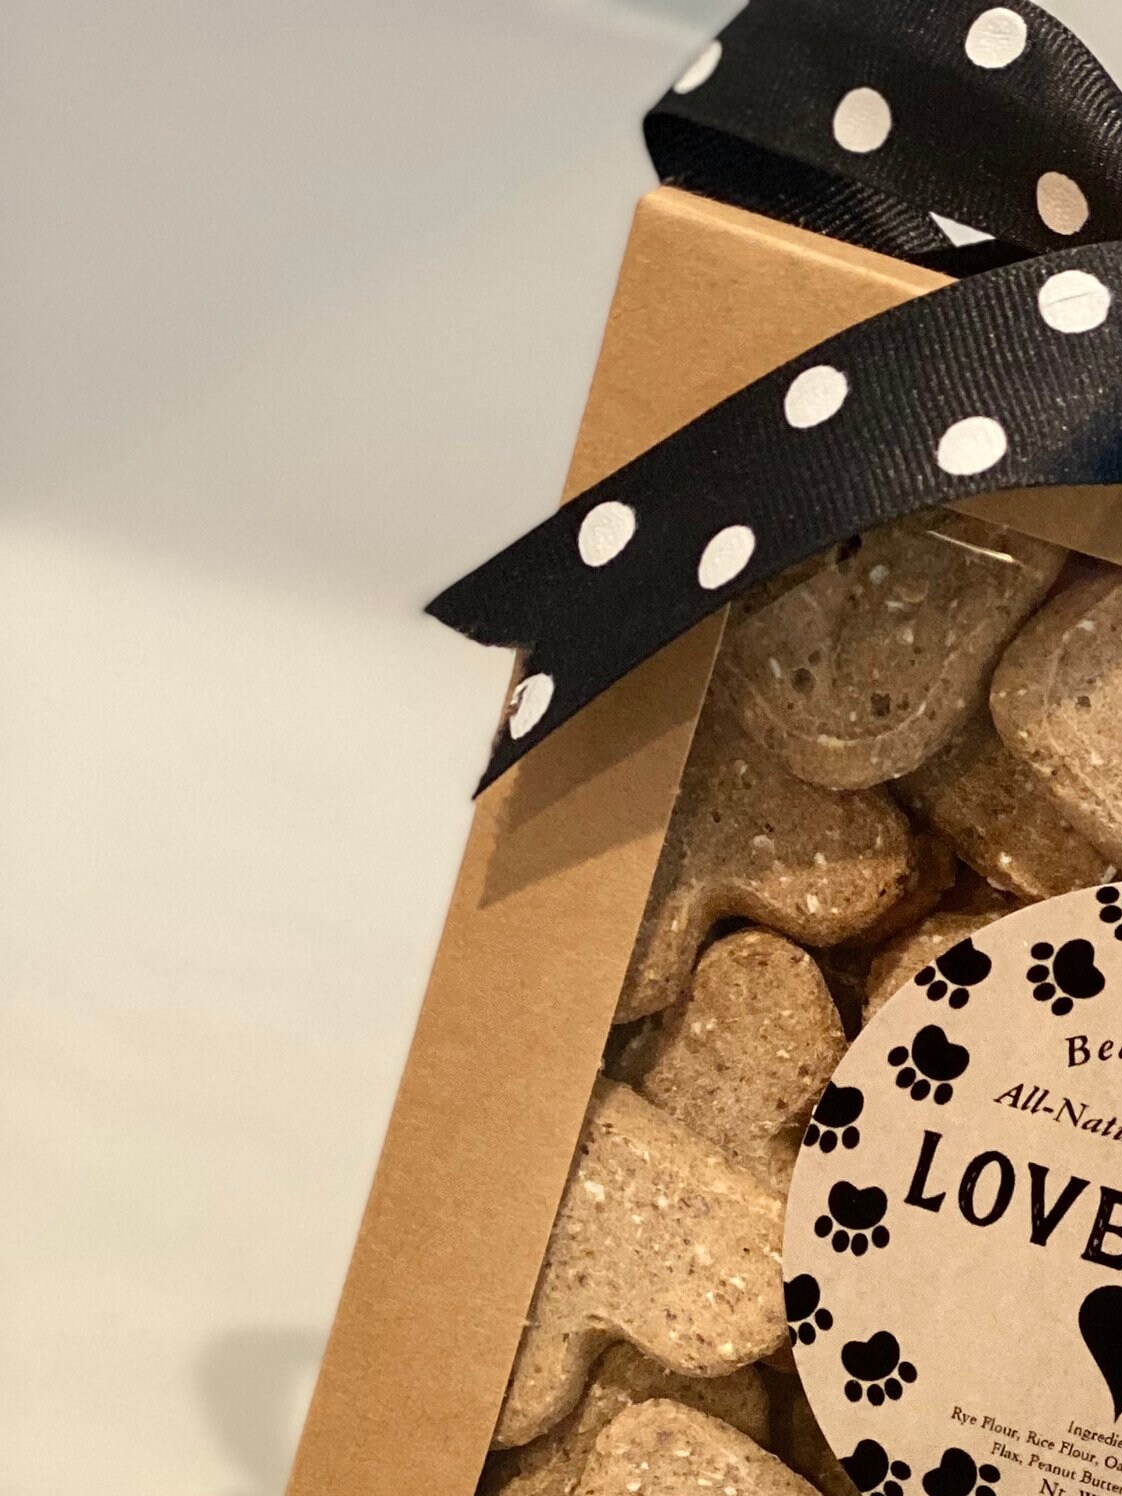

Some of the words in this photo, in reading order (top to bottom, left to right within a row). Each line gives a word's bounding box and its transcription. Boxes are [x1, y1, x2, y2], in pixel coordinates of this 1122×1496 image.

[951, 1406, 977, 1425] Rye
[981, 1416, 1020, 1441] Flour,
[1026, 1430, 1055, 1450] Rice
[1059, 1441, 1099, 1466] Flour,
[991, 1442, 1023, 1465] Flax,
[1028, 1453, 1077, 1480] Peanut
